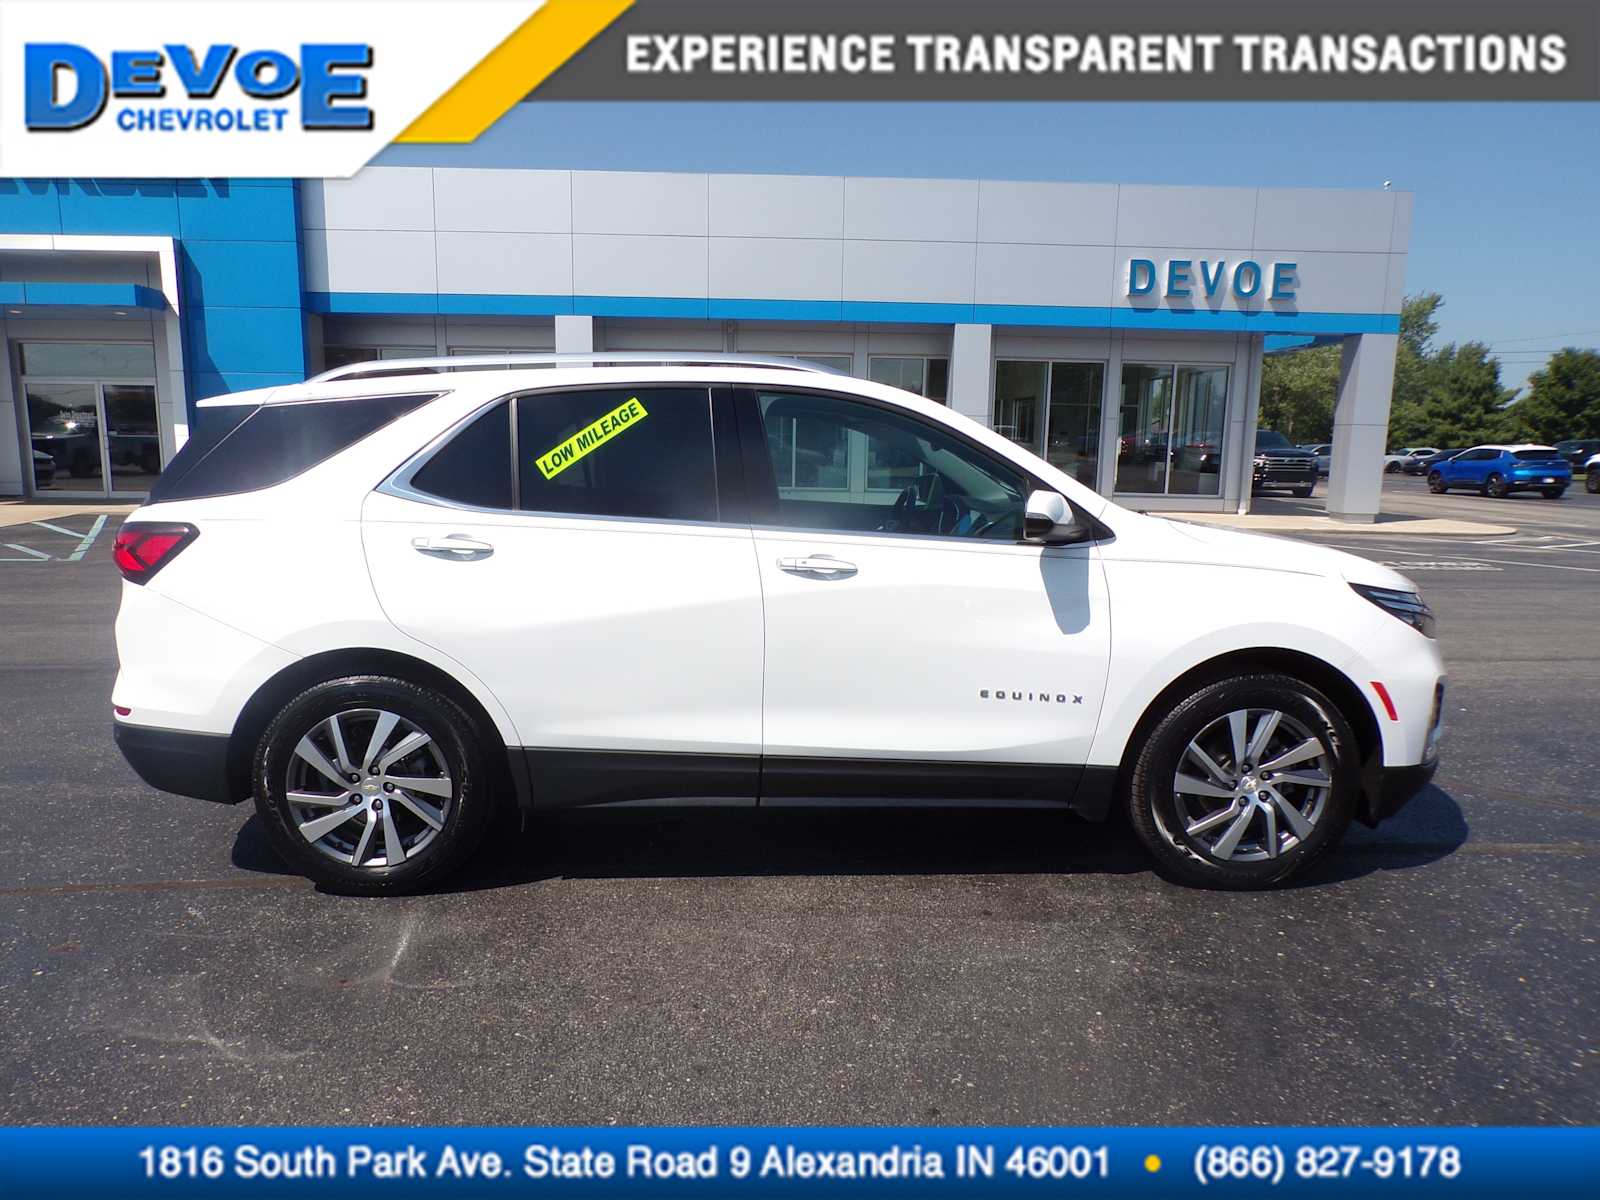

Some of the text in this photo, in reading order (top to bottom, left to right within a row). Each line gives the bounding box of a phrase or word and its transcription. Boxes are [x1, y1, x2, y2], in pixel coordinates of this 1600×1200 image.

[1128, 258, 1297, 301] DEVOE
[542, 402, 640, 475] LOW MILEAGE
[980, 689, 1083, 704] EQUINOX
